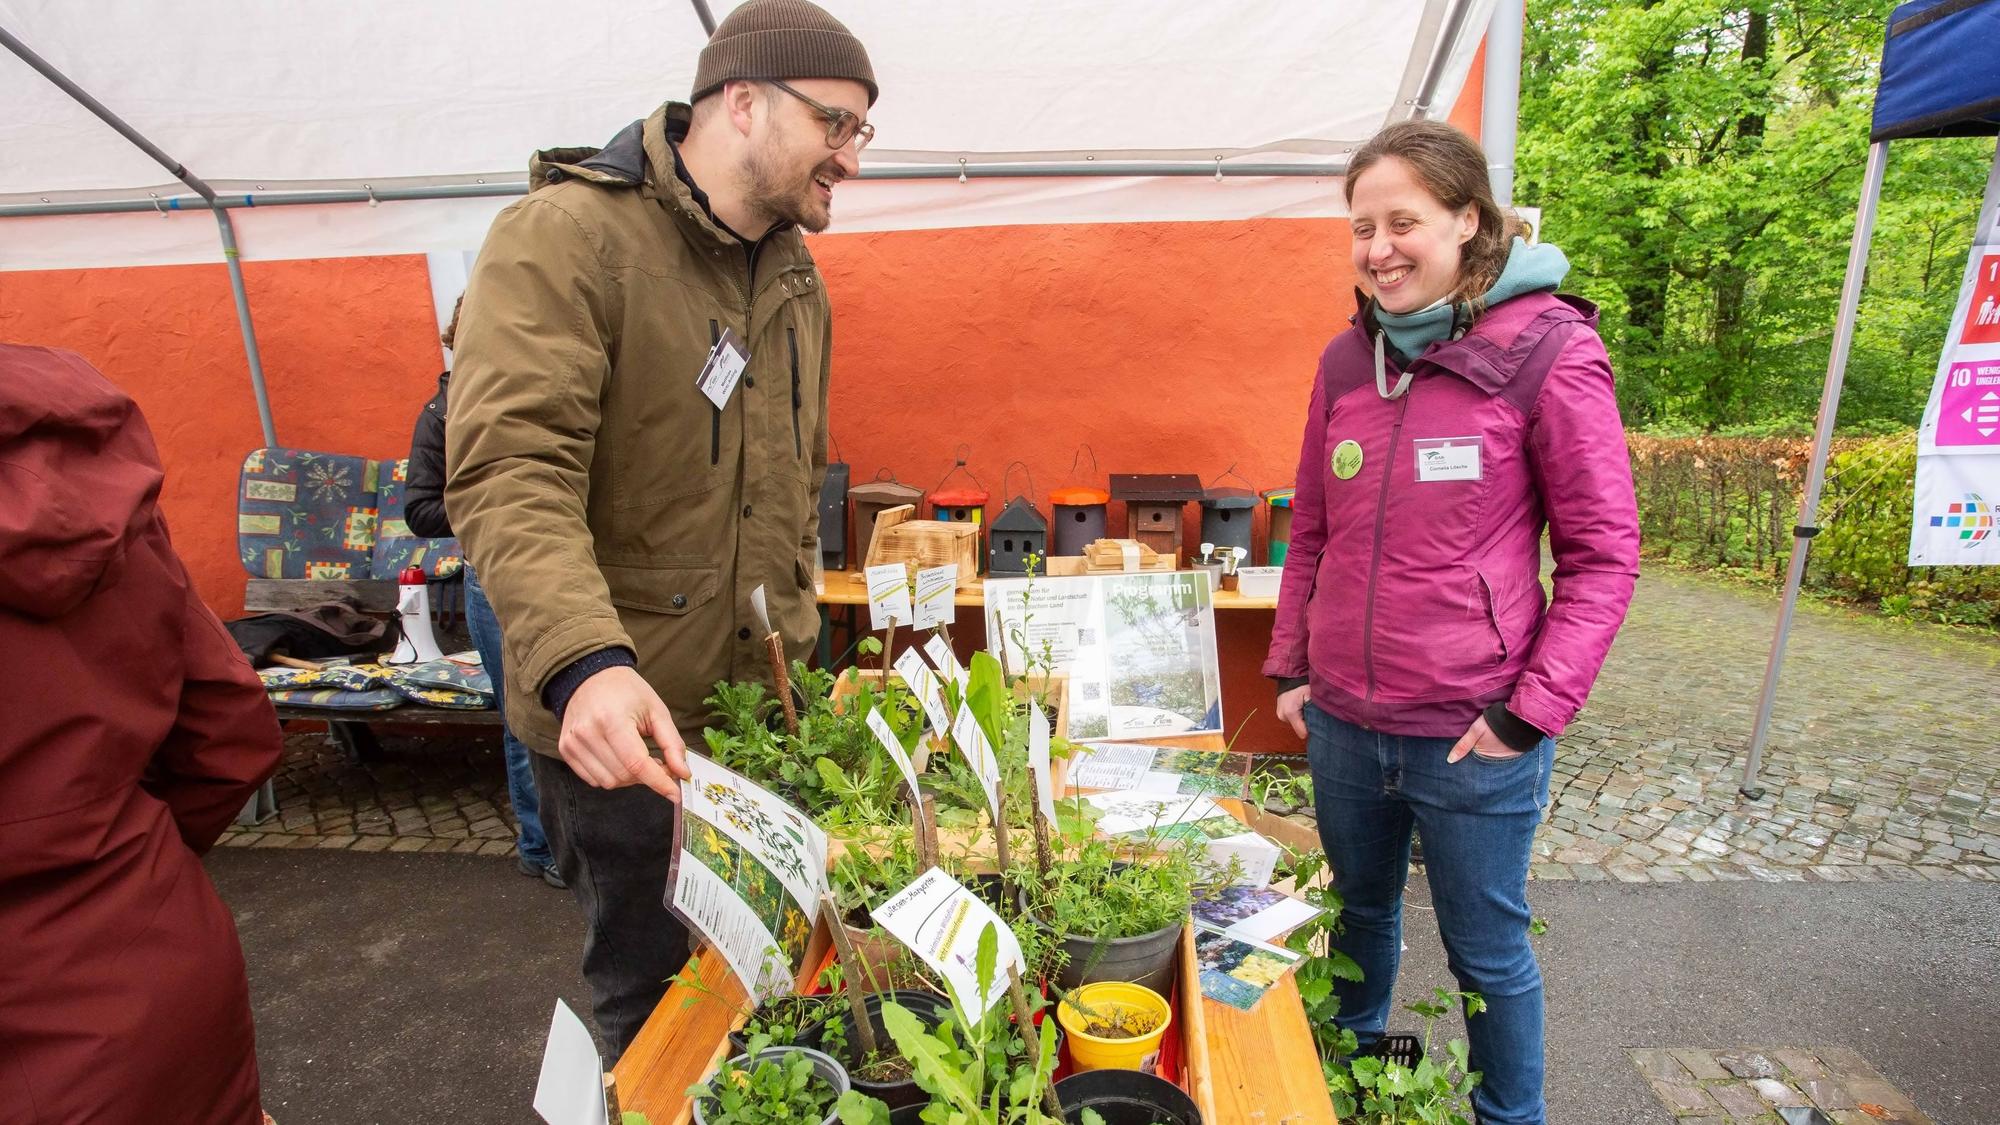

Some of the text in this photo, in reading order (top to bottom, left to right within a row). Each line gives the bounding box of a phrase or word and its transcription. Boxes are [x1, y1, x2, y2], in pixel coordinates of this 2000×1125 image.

[1990, 261, 1999, 282] 1
[1951, 368, 1972, 387] 10
[1112, 582, 1193, 601] Programm
[937, 946, 948, 962] echt
